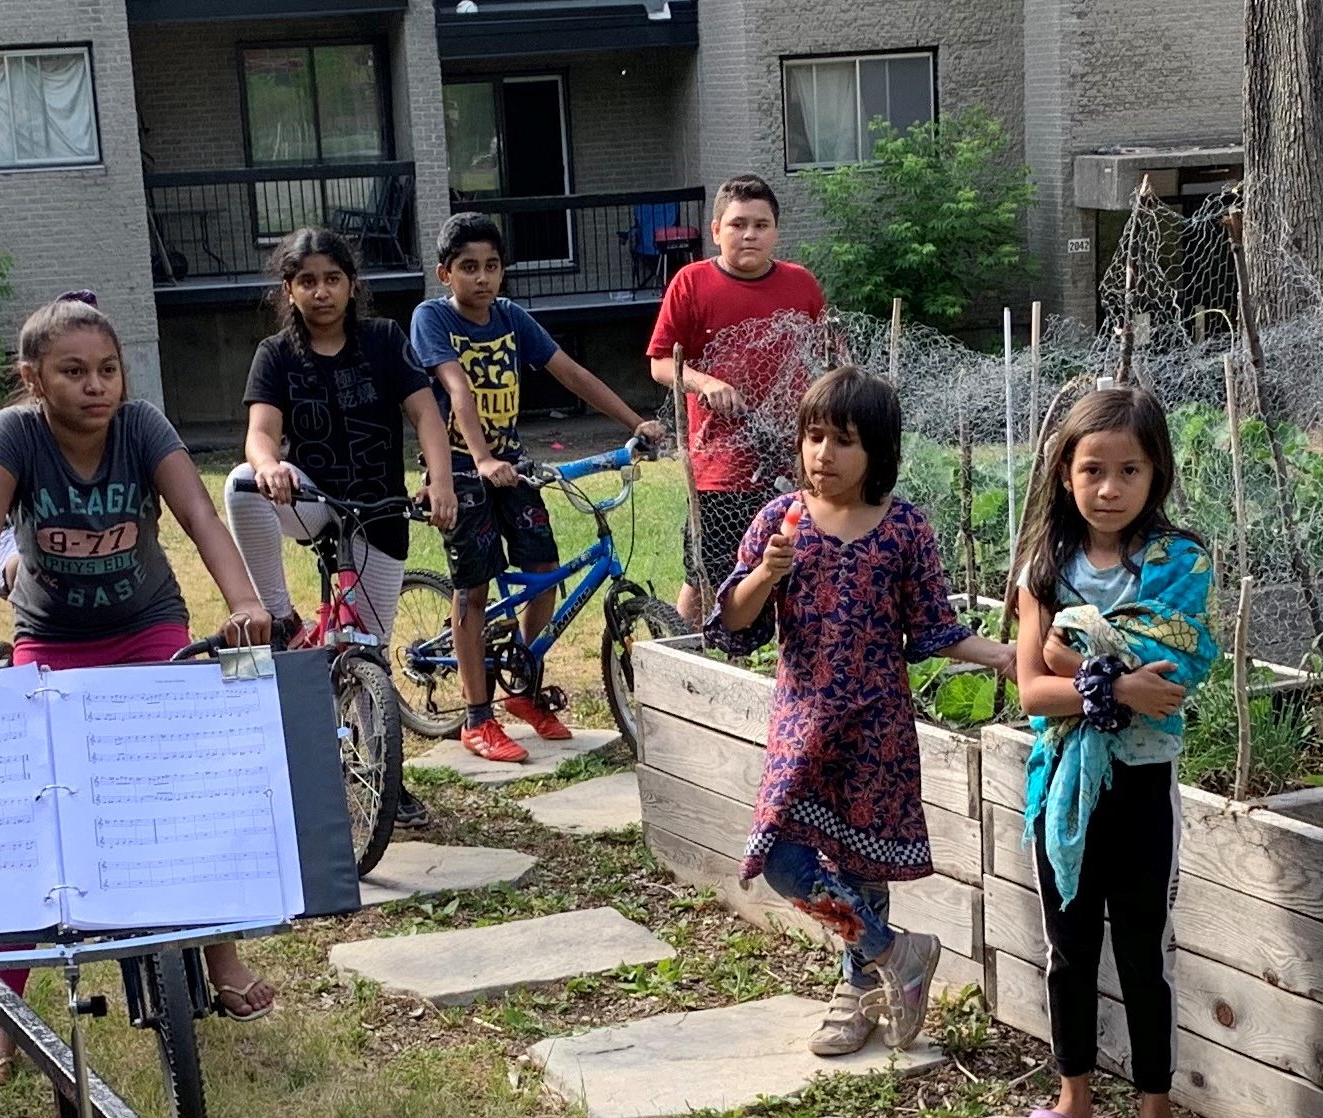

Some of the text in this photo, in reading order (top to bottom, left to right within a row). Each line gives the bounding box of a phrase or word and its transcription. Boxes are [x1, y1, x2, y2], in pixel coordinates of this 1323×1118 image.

[1069, 240, 1090, 252] 2042
[471, 389, 516, 414] ALLY
[287, 371, 351, 483] per
[29, 482, 154, 523] M. EAGLE
[49, 526, 126, 555] 9-77
[49, 556, 124, 574] PHYS ED
[67, 565, 147, 608] BASE
[555, 586, 592, 635] Miele
